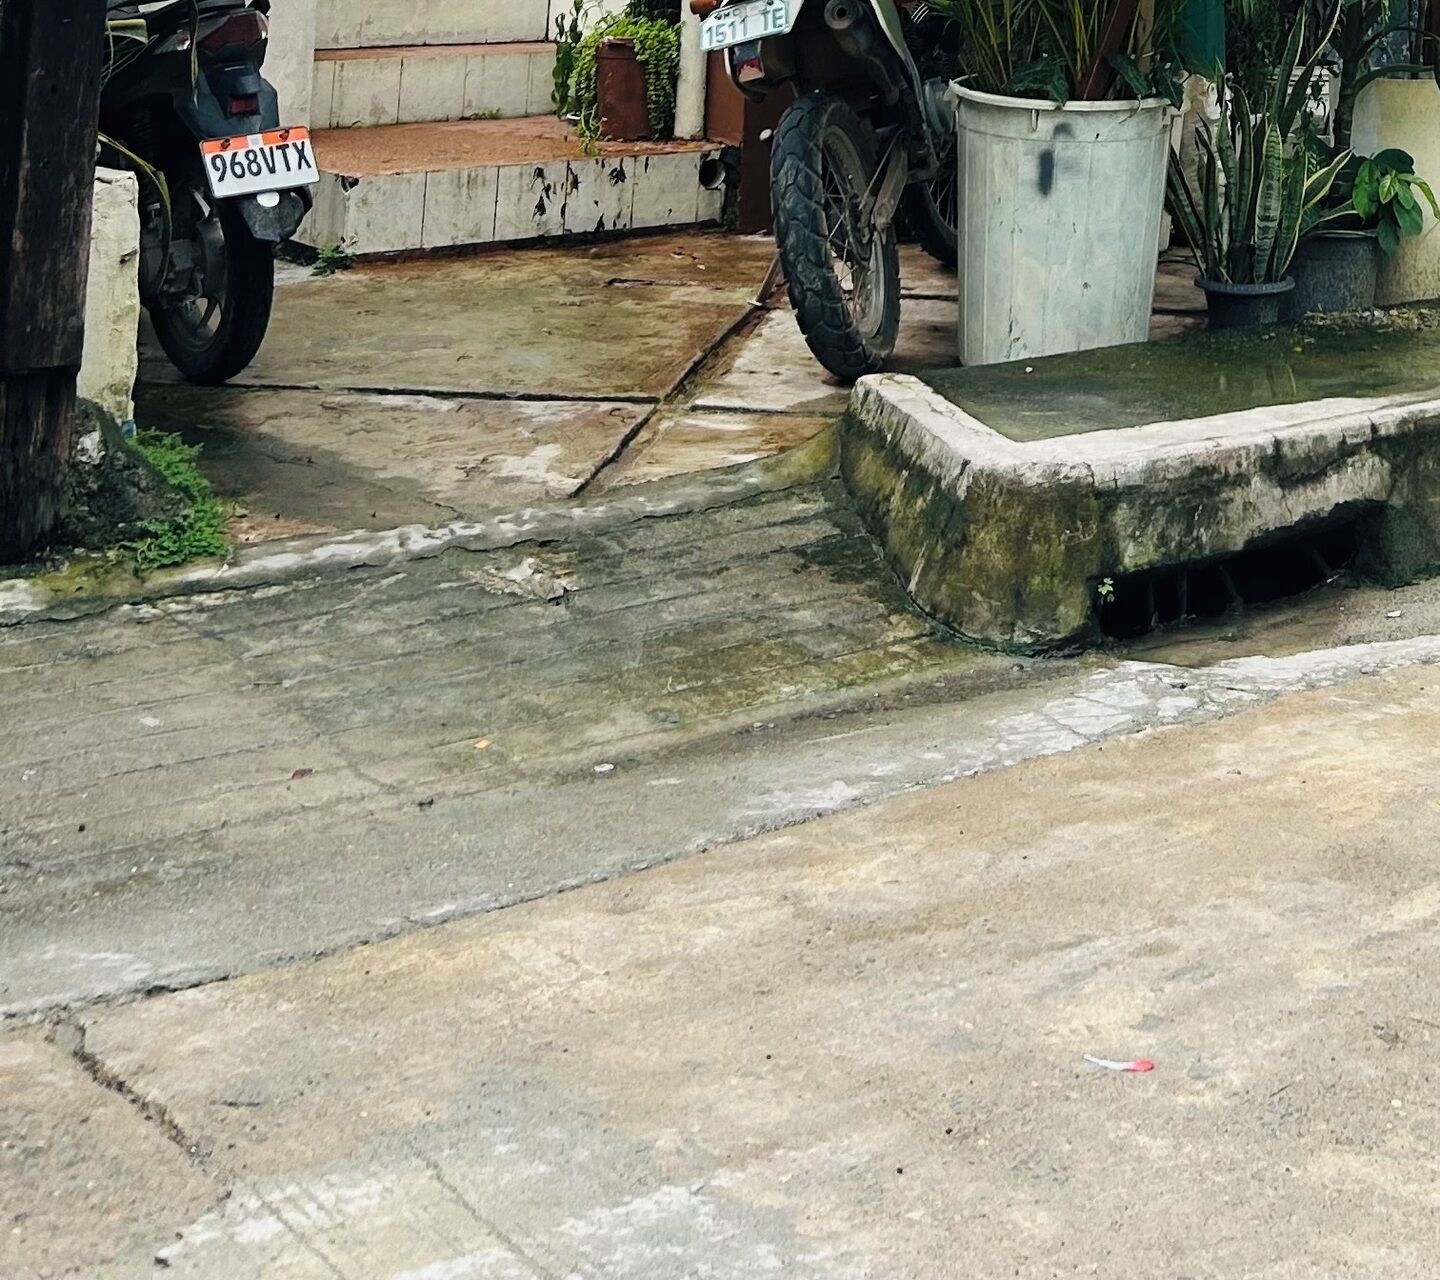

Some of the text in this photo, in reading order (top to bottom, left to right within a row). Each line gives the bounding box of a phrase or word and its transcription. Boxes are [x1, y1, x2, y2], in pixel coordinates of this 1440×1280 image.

[706, 7, 784, 47] 1511 TE
[210, 141, 312, 183] 968VTX
